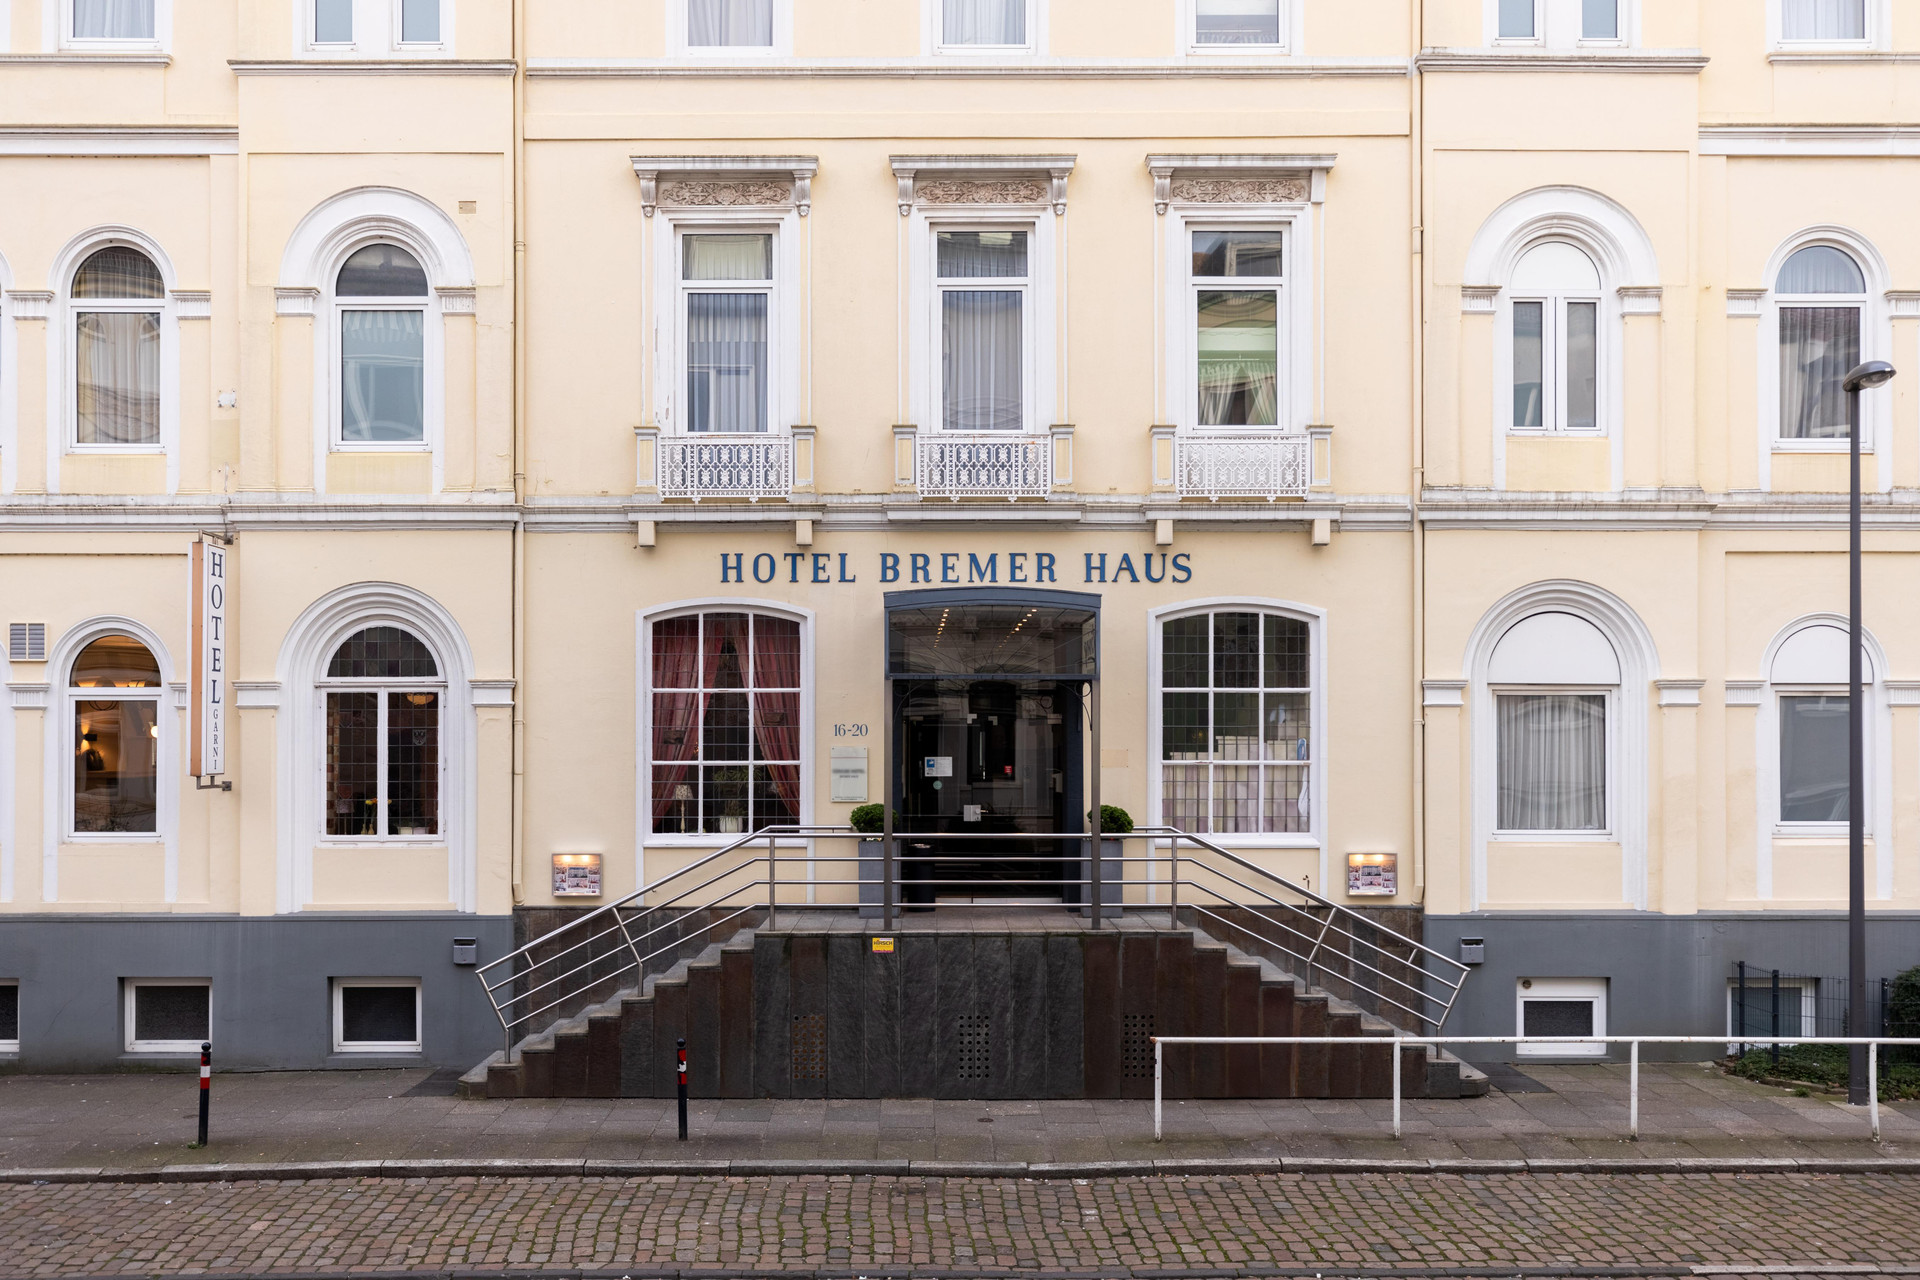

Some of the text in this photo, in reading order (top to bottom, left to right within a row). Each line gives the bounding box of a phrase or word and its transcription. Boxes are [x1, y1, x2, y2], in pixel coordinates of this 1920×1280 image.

[720, 553, 1192, 583] HOTEL BREMER HAUS
[211, 551, 223, 704] HOTEL
[834, 723, 868, 737] 16-20
